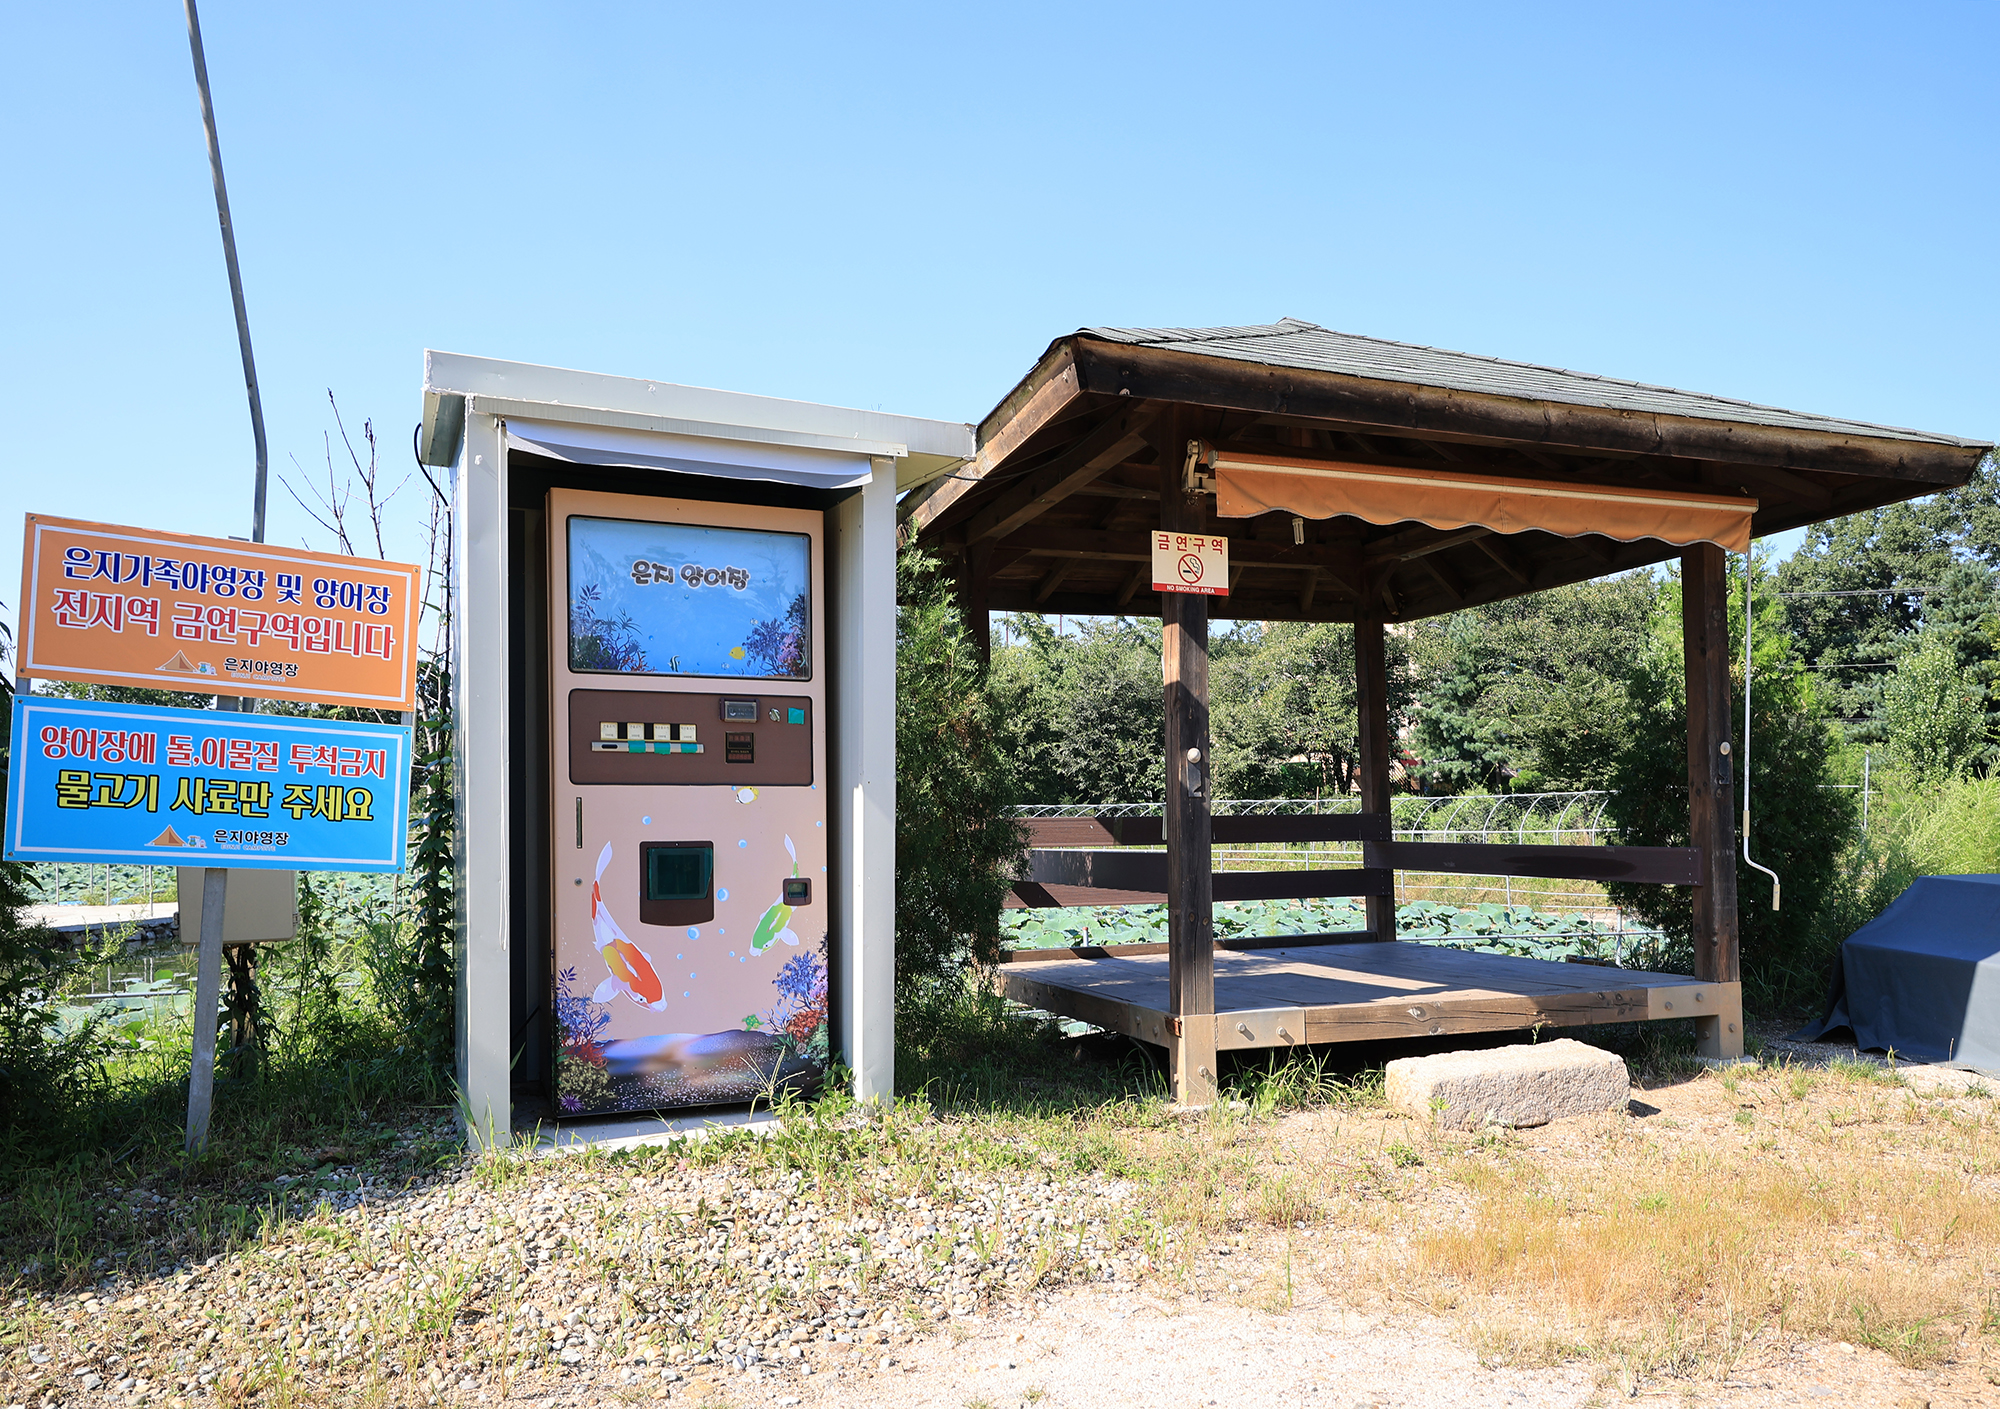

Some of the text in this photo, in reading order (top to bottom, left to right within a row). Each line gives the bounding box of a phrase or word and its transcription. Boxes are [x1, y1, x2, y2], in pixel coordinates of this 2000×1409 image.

[63, 546, 392, 615] 은지가족야영장 및 양어장
[630, 559, 750, 590] 은지 양어장
[51, 588, 397, 661] 전지역 금연구역입니다
[223, 657, 299, 677] 은지야영장
[40, 725, 387, 779] 양어장에 돌,이물질 투척금지
[55, 769, 374, 822] 물고기 사료만 주세요
[213, 829, 289, 846] 은지야영장
